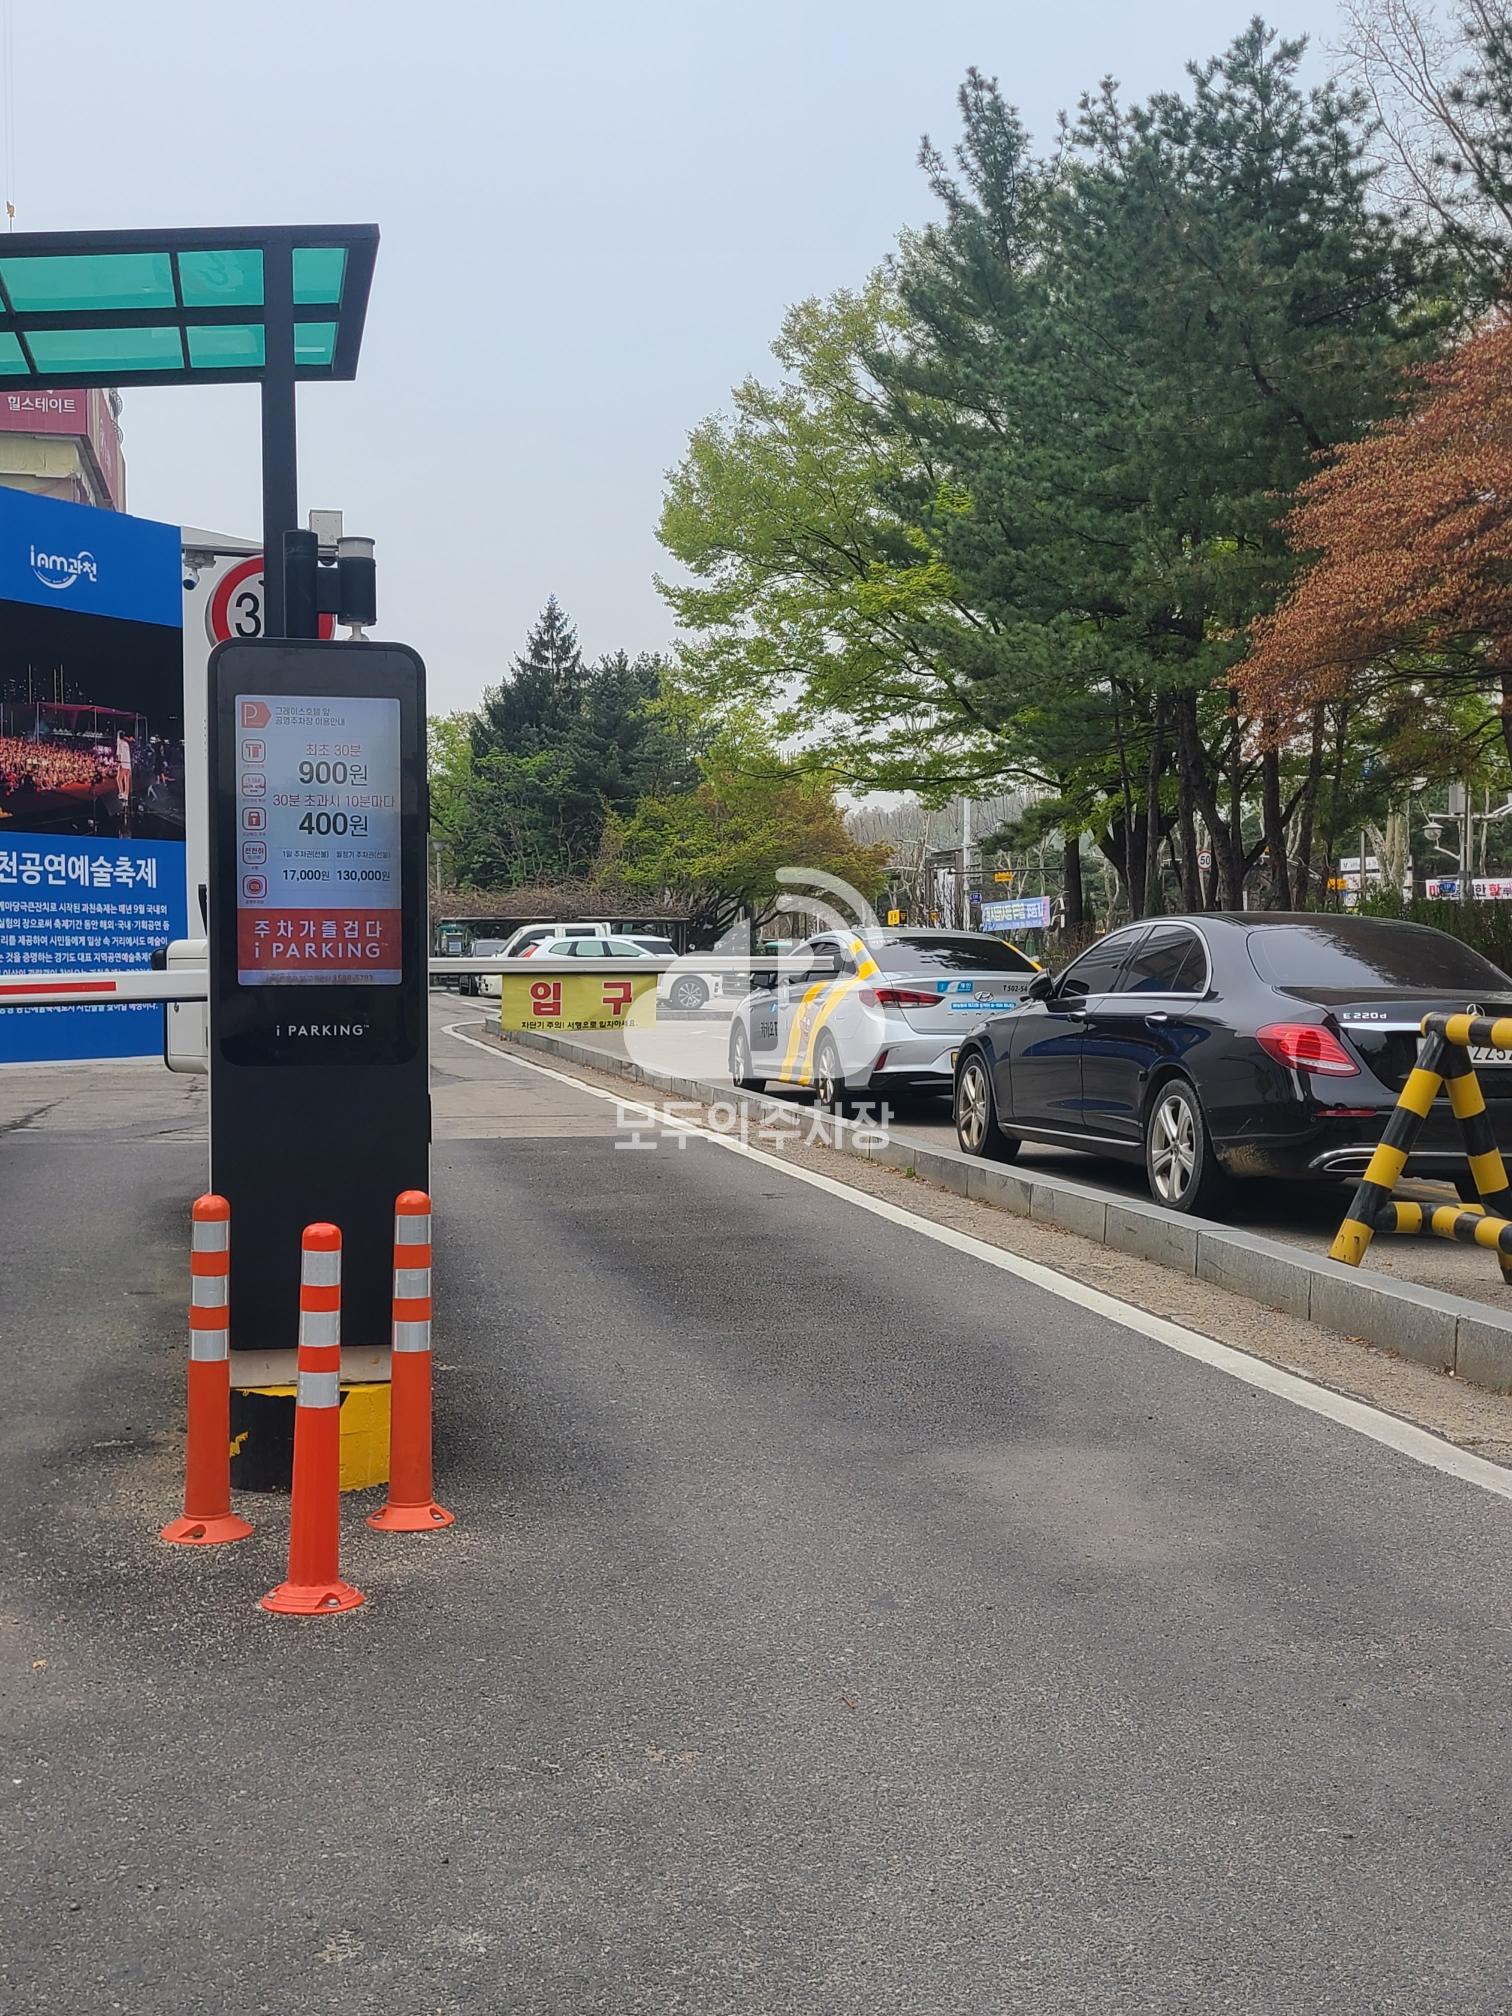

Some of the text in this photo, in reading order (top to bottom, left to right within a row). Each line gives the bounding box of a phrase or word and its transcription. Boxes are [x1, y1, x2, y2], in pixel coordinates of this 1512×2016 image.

[8, 396, 77, 413] 힐스테이트
[306, 743, 361, 757] 최초 30분
[298, 760, 368, 786] 900원
[272, 794, 301, 808] 30분
[304, 794, 340, 808] 초과시
[345, 795, 395, 809] 10분마다
[298, 811, 368, 837] 400원
[1200, 855, 1211, 866] 50
[282, 869, 391, 882] 17,000원 130,000원
[58, 902, 81, 914] 시작된
[133, 904, 145, 914] 9월
[146, 904, 168, 915] 국내외
[17, 935, 48, 946] 제공하여
[111, 936, 147, 947] 거리에서도
[54, 952, 77, 963] 경기도
[77, 952, 92, 963] 대표
